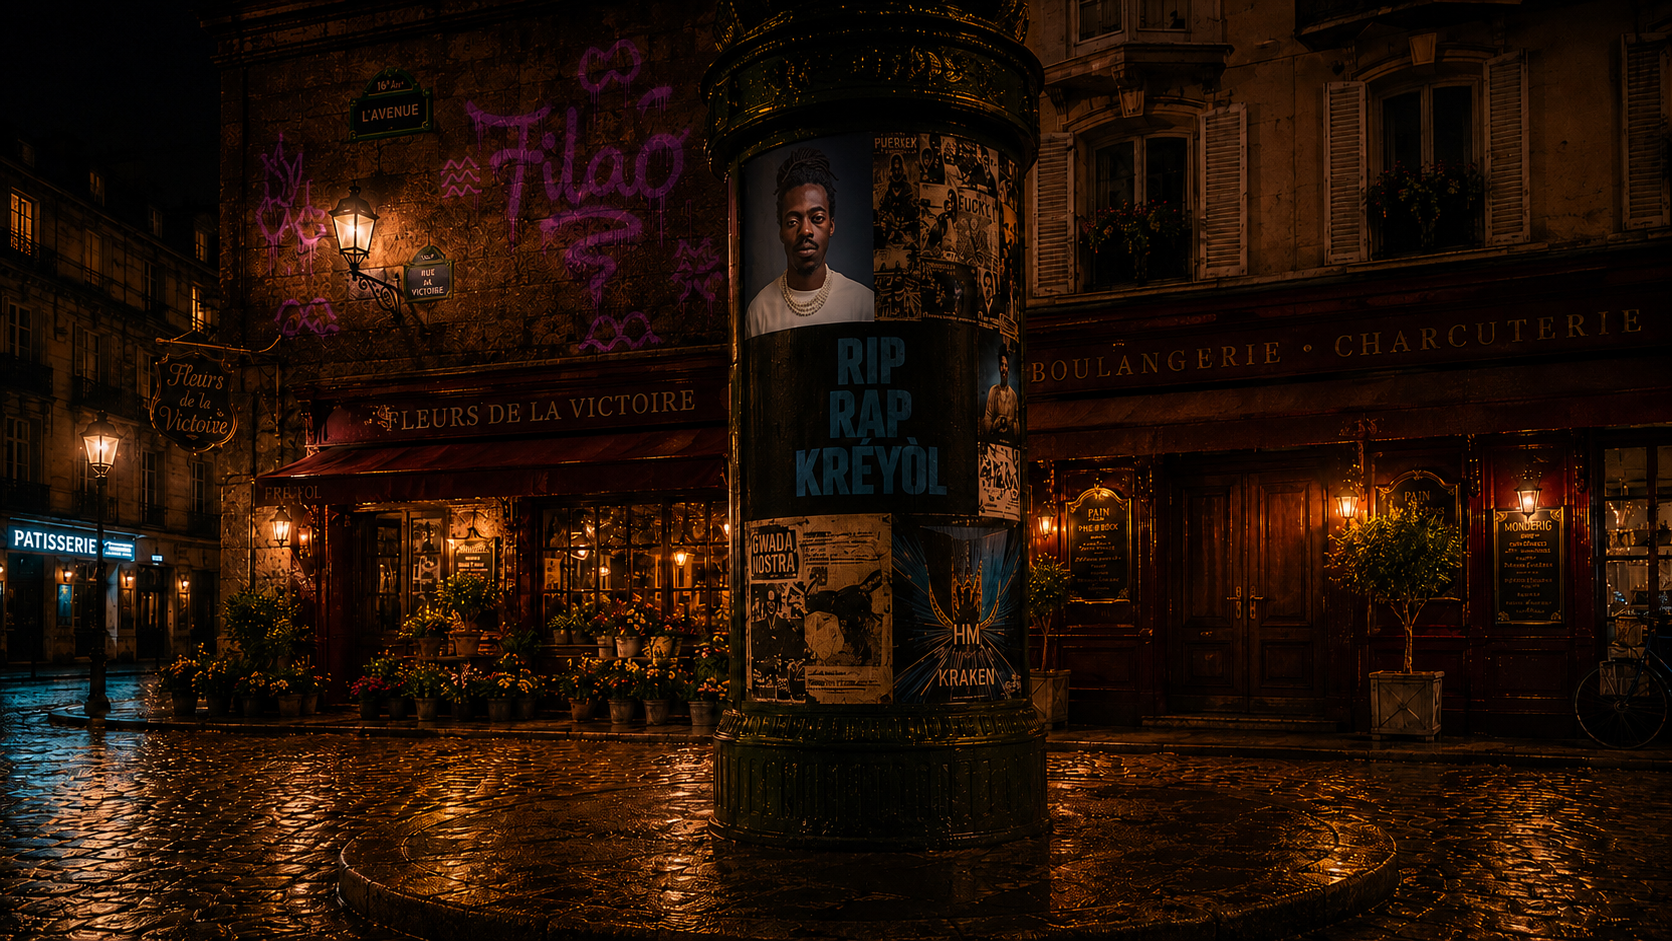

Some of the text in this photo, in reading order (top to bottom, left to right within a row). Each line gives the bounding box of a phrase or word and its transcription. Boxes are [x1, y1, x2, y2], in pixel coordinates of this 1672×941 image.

[361, 103, 419, 123] L'AVENUE
[1334, 308, 1642, 358] CHARCUTERIE
[837, 336, 906, 386] RIP
[1031, 341, 1281, 383] BOULANGERIE
[167, 362, 224, 390] Fleurs
[180, 390, 211, 410] de la
[387, 389, 696, 432] FLEURS DE LA VICTOIRE
[829, 389, 912, 439] RAP
[796, 436, 948, 497] KRÉYÒL
[1404, 490, 1430, 502] PAIN
[1088, 507, 1110, 518] PAIN
[14, 529, 97, 554] PATISSERIE
[752, 532, 793, 553] GWADA
[953, 623, 980, 645] HM
[938, 667, 995, 688] KRAKEN
